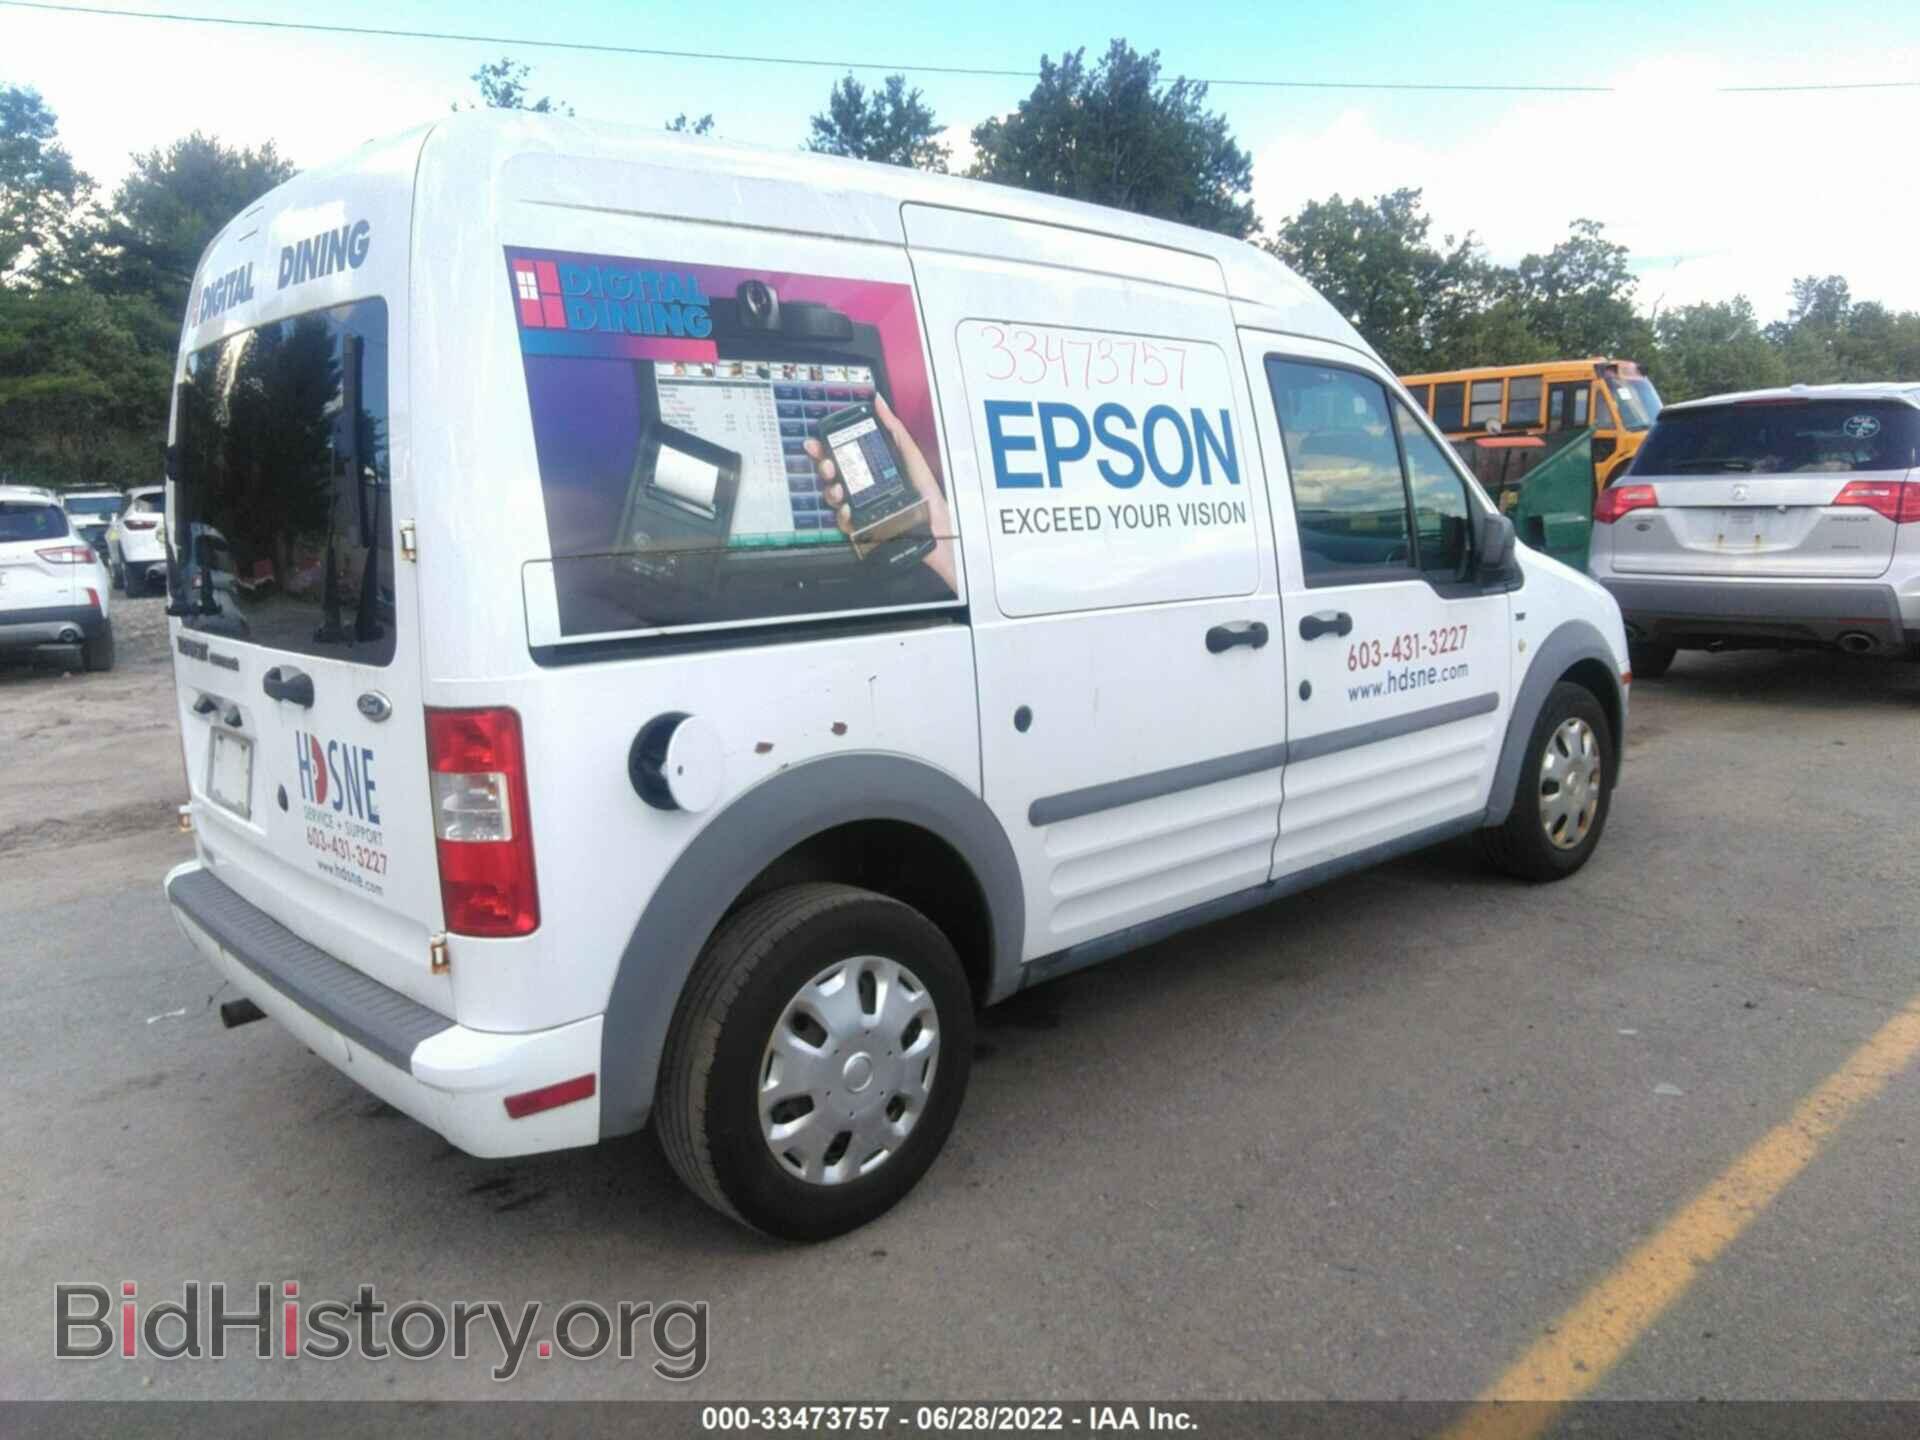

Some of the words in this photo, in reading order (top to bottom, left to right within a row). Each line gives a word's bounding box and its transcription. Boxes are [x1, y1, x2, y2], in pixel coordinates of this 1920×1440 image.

[200, 261, 254, 324] DIGITAL
[278, 219, 370, 290] DINING
[559, 261, 710, 306] DIGITAL
[566, 300, 712, 338] DINING
[981, 325, 1187, 391] 33473757
[984, 400, 1240, 489] EPSON
[1000, 506, 1101, 535] EXCEED
[1108, 504, 1171, 529] YOUR
[1177, 501, 1247, 526] VISION
[1347, 624, 1468, 672] 603-431-3227
[1348, 662, 1469, 701] www.hdsne.com
[306, 826, 388, 876] 603-431-3227
[345, 821, 384, 847] SUPPORT
